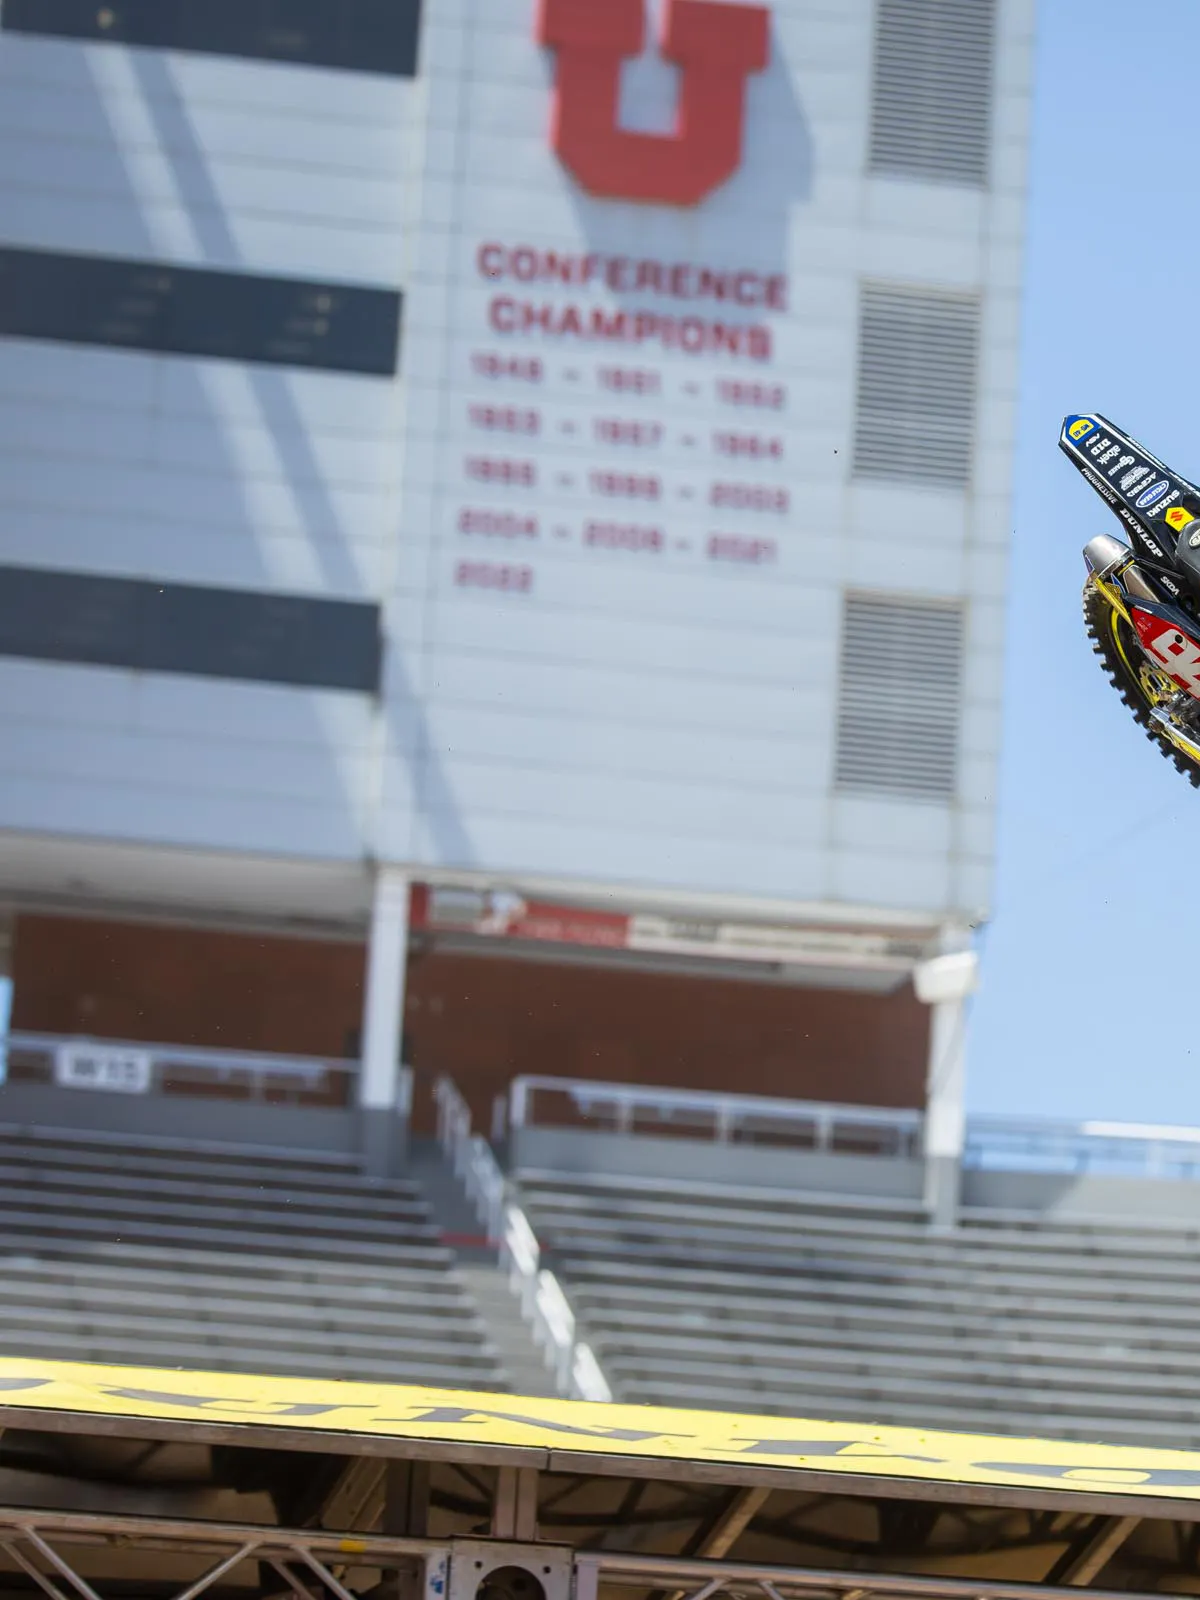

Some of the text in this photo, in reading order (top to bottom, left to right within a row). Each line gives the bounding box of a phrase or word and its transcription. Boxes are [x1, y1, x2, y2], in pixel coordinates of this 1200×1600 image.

[534, 0, 770, 207] U
[477, 241, 788, 312] CONFERENCE
[489, 293, 773, 364] CHAMPIONS
[1081, 467, 1118, 504] PROGRESSIVE
[1146, 489, 1180, 517] SUZUKI
[1119, 508, 1163, 557] DUNLOP
